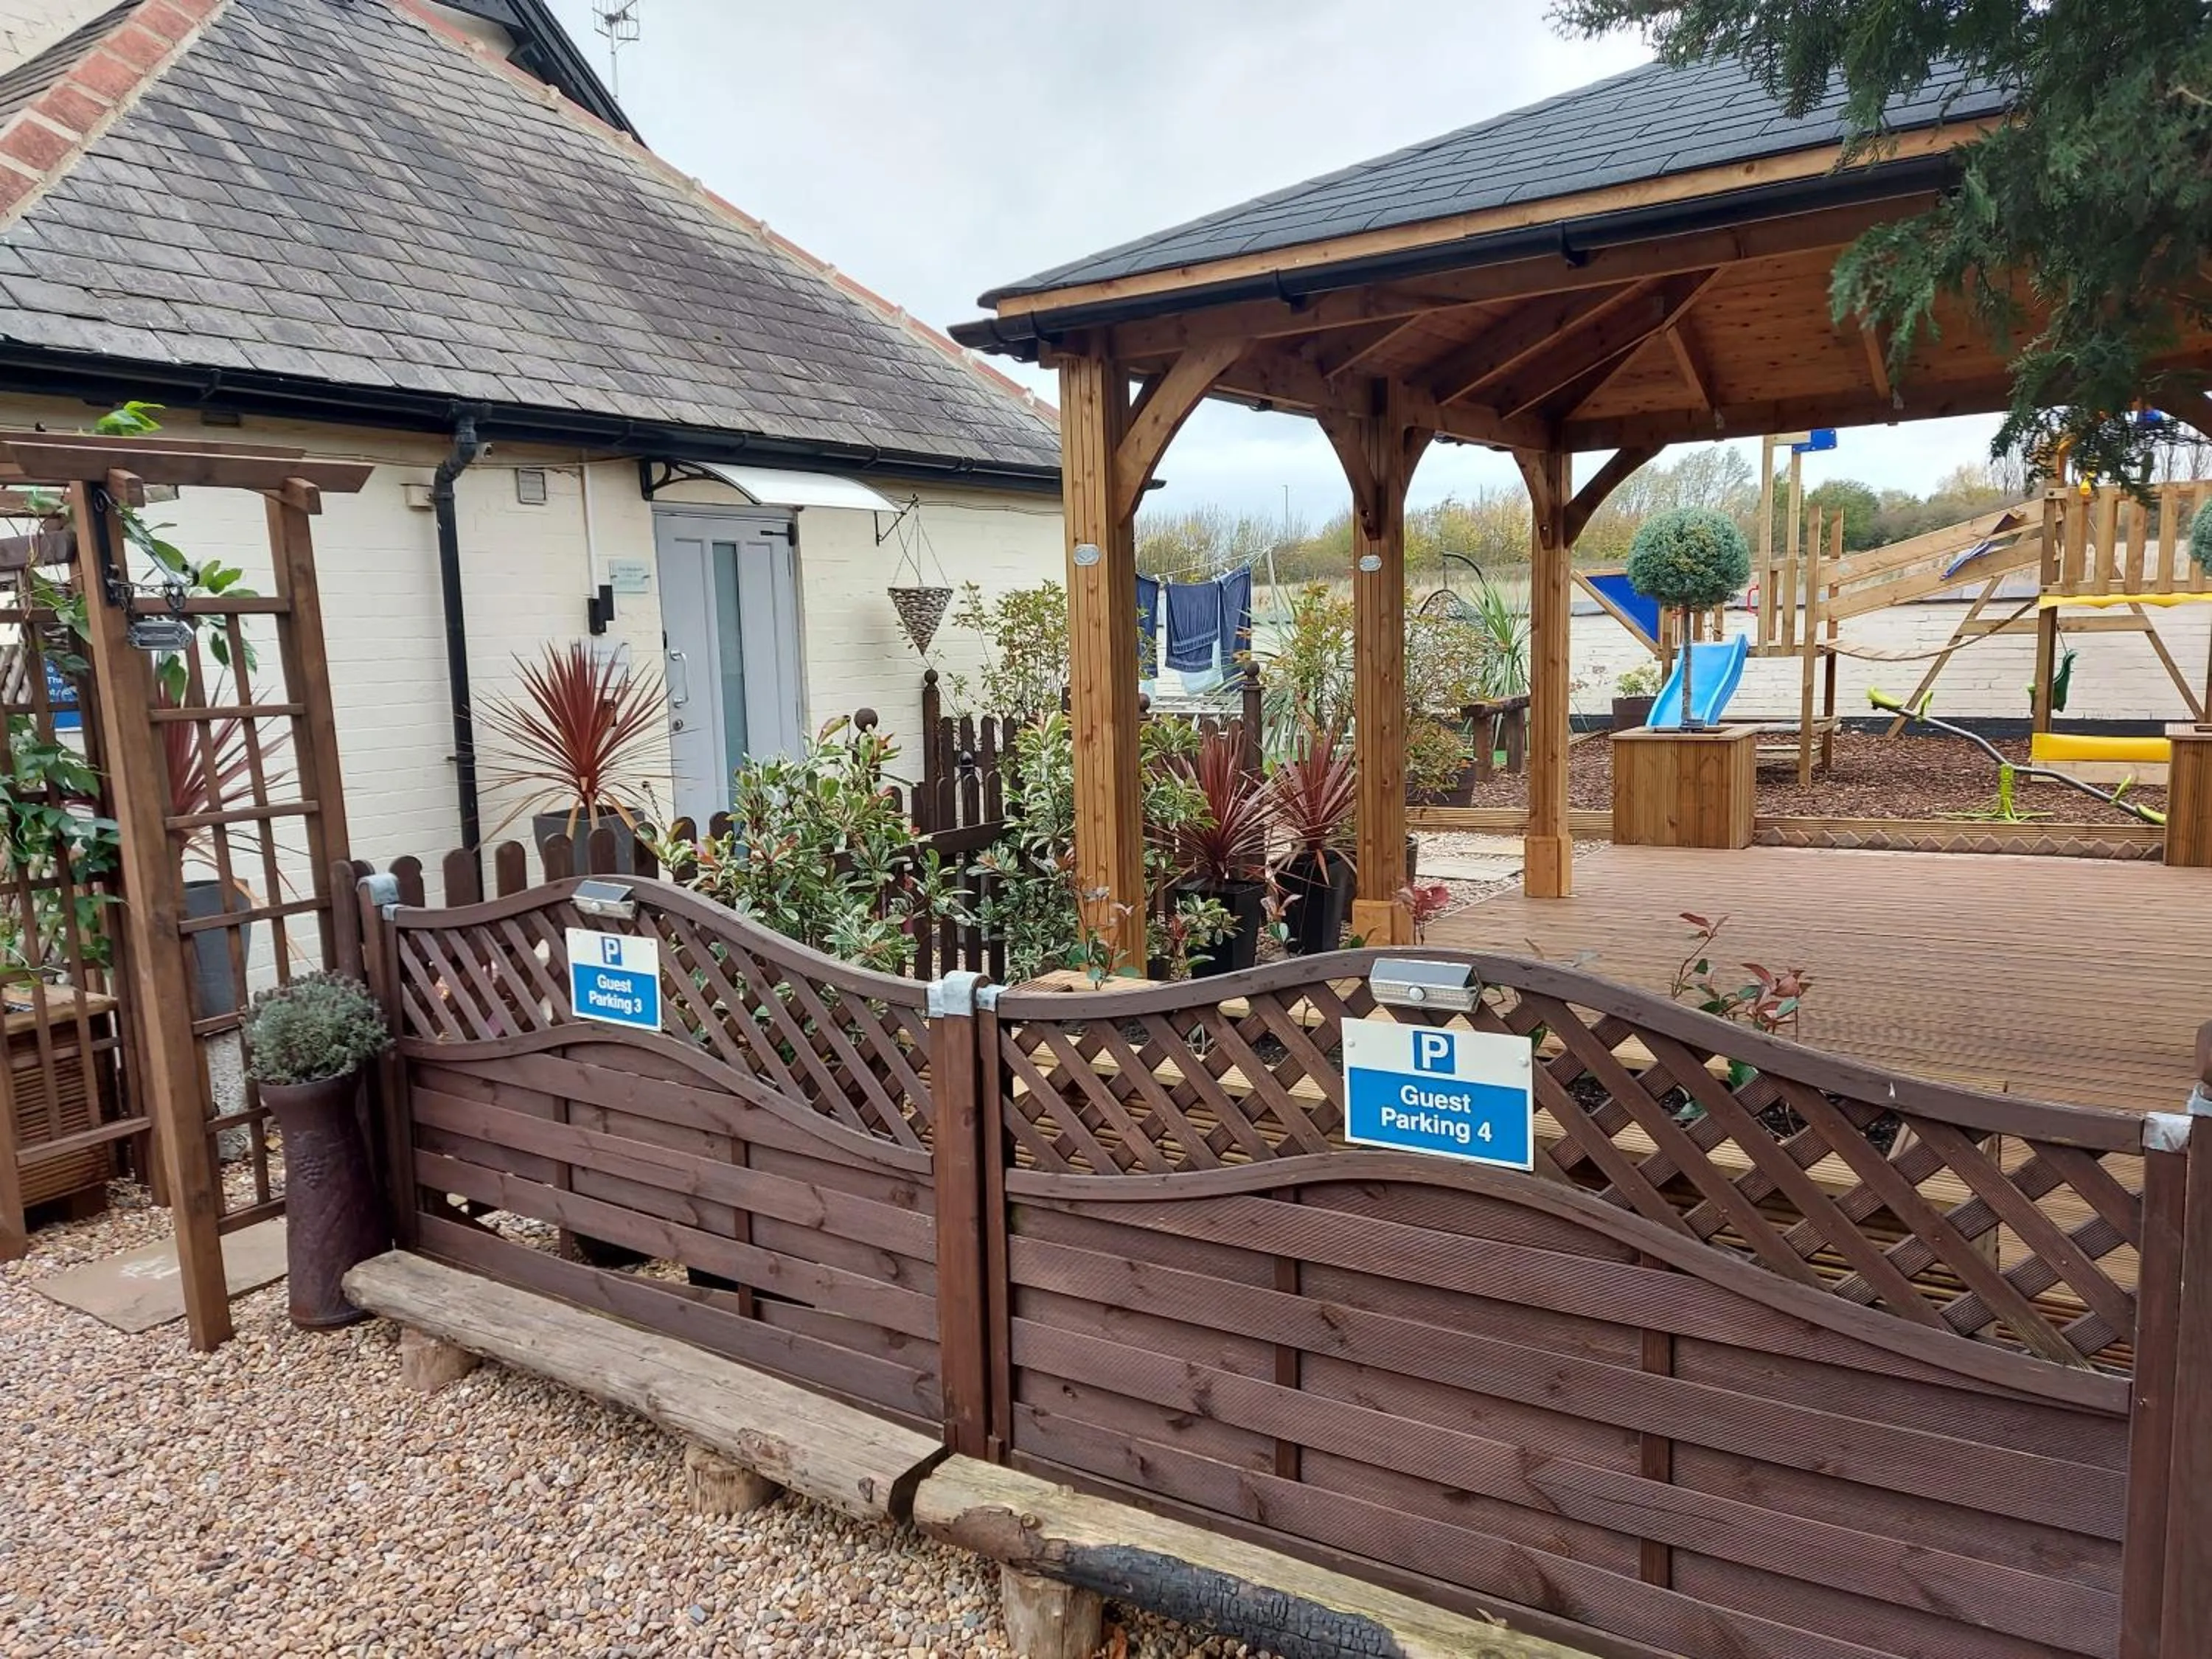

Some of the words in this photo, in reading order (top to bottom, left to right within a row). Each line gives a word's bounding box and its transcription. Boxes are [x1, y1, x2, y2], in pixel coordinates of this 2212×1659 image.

[605, 938, 620, 964] P
[597, 974, 632, 993] Guest
[588, 991, 632, 1014] Parking
[634, 998, 642, 1013] 3
[1420, 1033, 1449, 1070] P
[1400, 1085, 1472, 1113] Guest
[1380, 1107, 1471, 1144] Parking
[1477, 1122, 1493, 1142] 4
